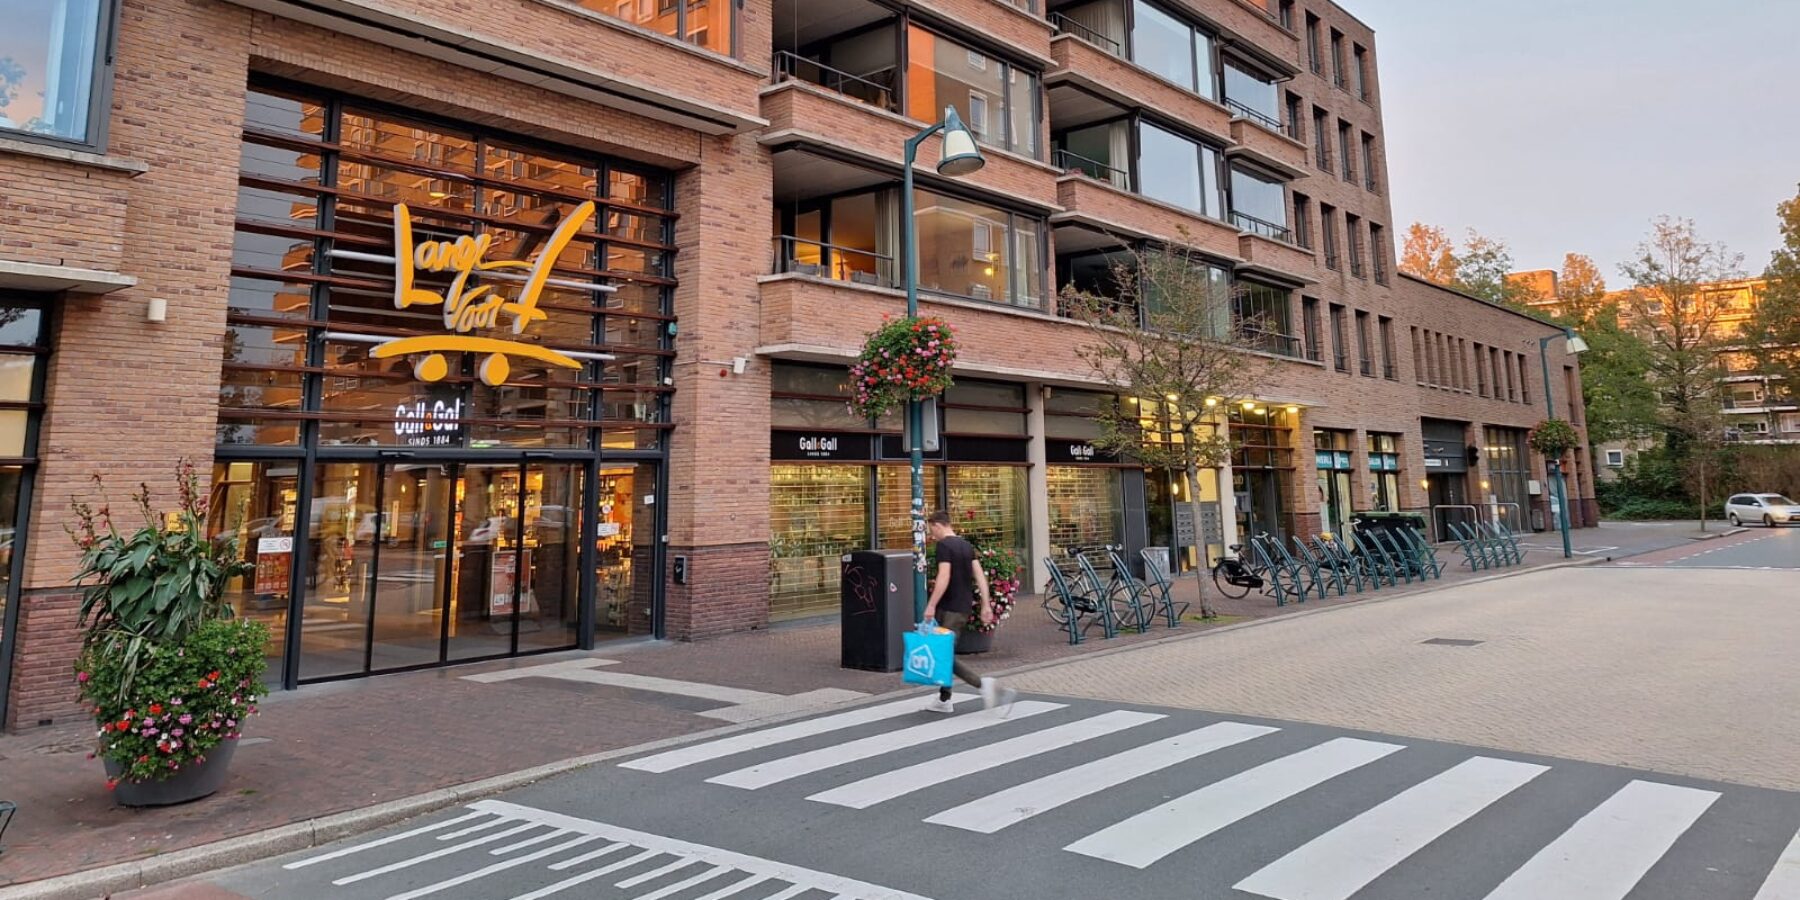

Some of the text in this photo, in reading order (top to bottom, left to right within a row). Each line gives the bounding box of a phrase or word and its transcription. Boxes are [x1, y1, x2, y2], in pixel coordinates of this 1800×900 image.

[394, 202, 500, 318] Lange
[408, 434, 450, 446] SINDS 1884
